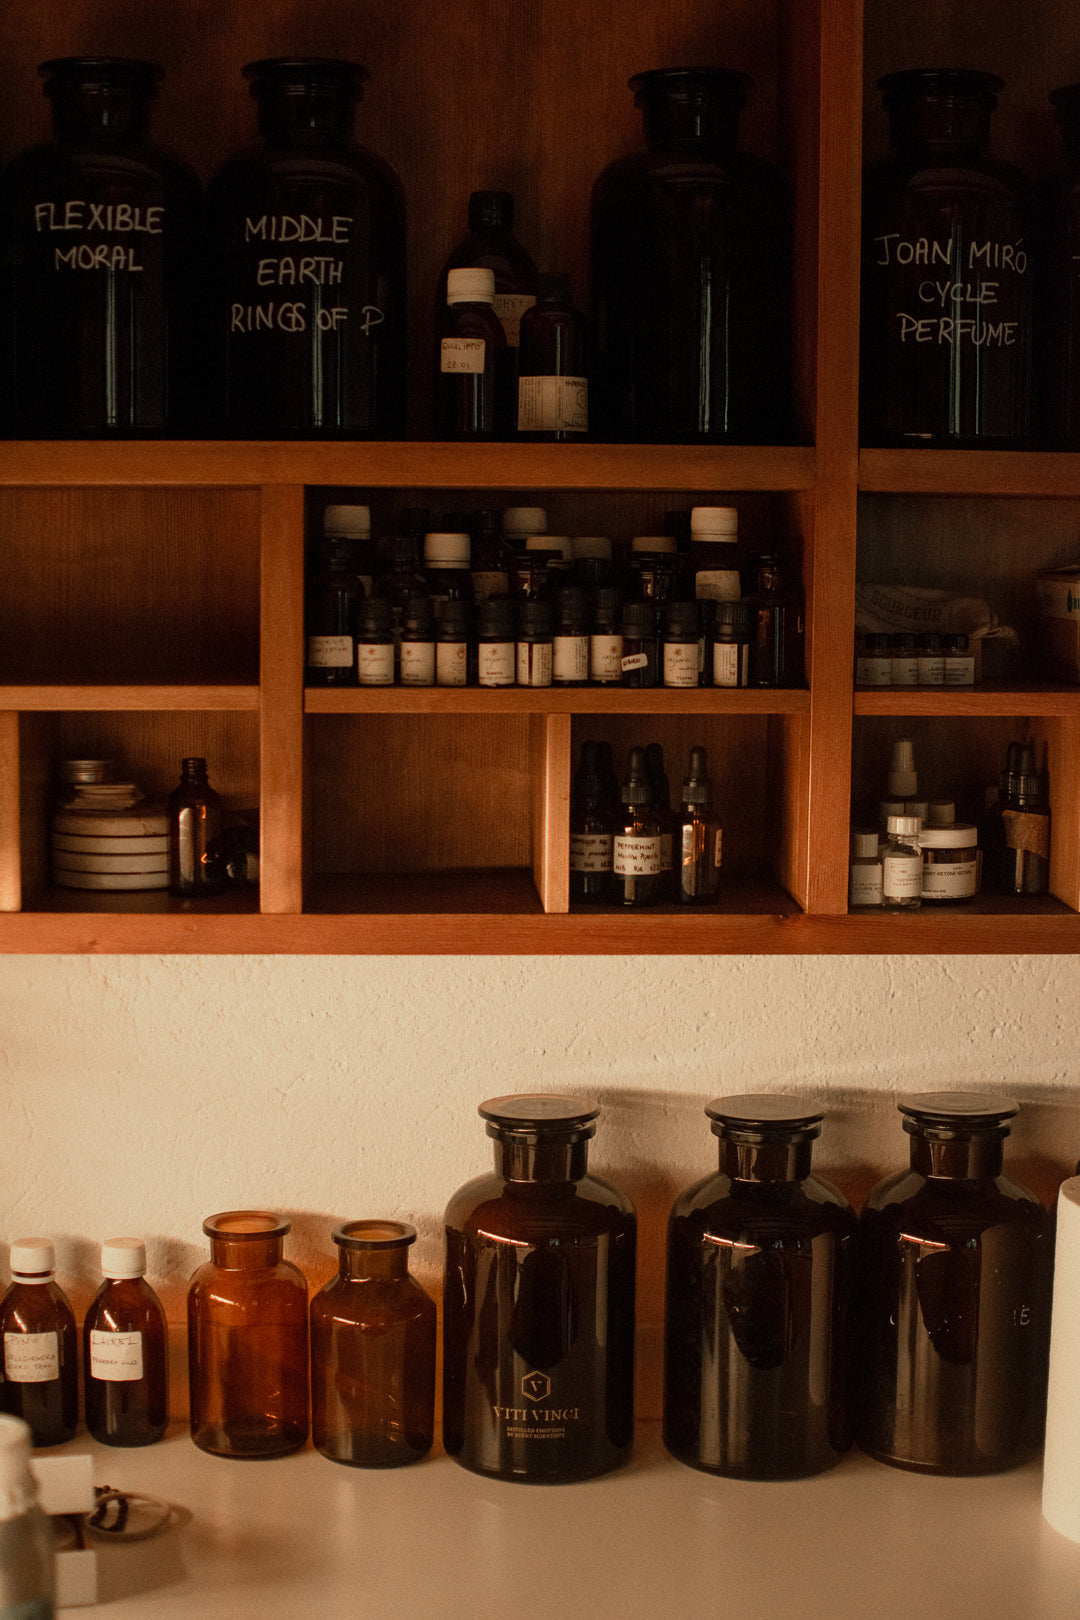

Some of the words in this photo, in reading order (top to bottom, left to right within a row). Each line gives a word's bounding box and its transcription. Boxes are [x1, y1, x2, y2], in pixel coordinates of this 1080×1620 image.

[34, 200, 165, 234] FLEXIBLE
[245, 214, 353, 244] MIDDLE
[54, 245, 144, 272] MORAL
[873, 233, 953, 266] JOAN
[968, 237, 1027, 274] MIRÓ
[256, 256, 344, 287] EARTH
[918, 280, 999, 307] CYCLE
[231, 302, 307, 333] RINGS
[317, 307, 349, 332] OF
[896, 312, 1018, 347] PERFUME
[92, 1334, 138, 1347] LAUREL
[493, 1405, 528, 1421] VITI
[531, 1407, 580, 1422] VINCI
